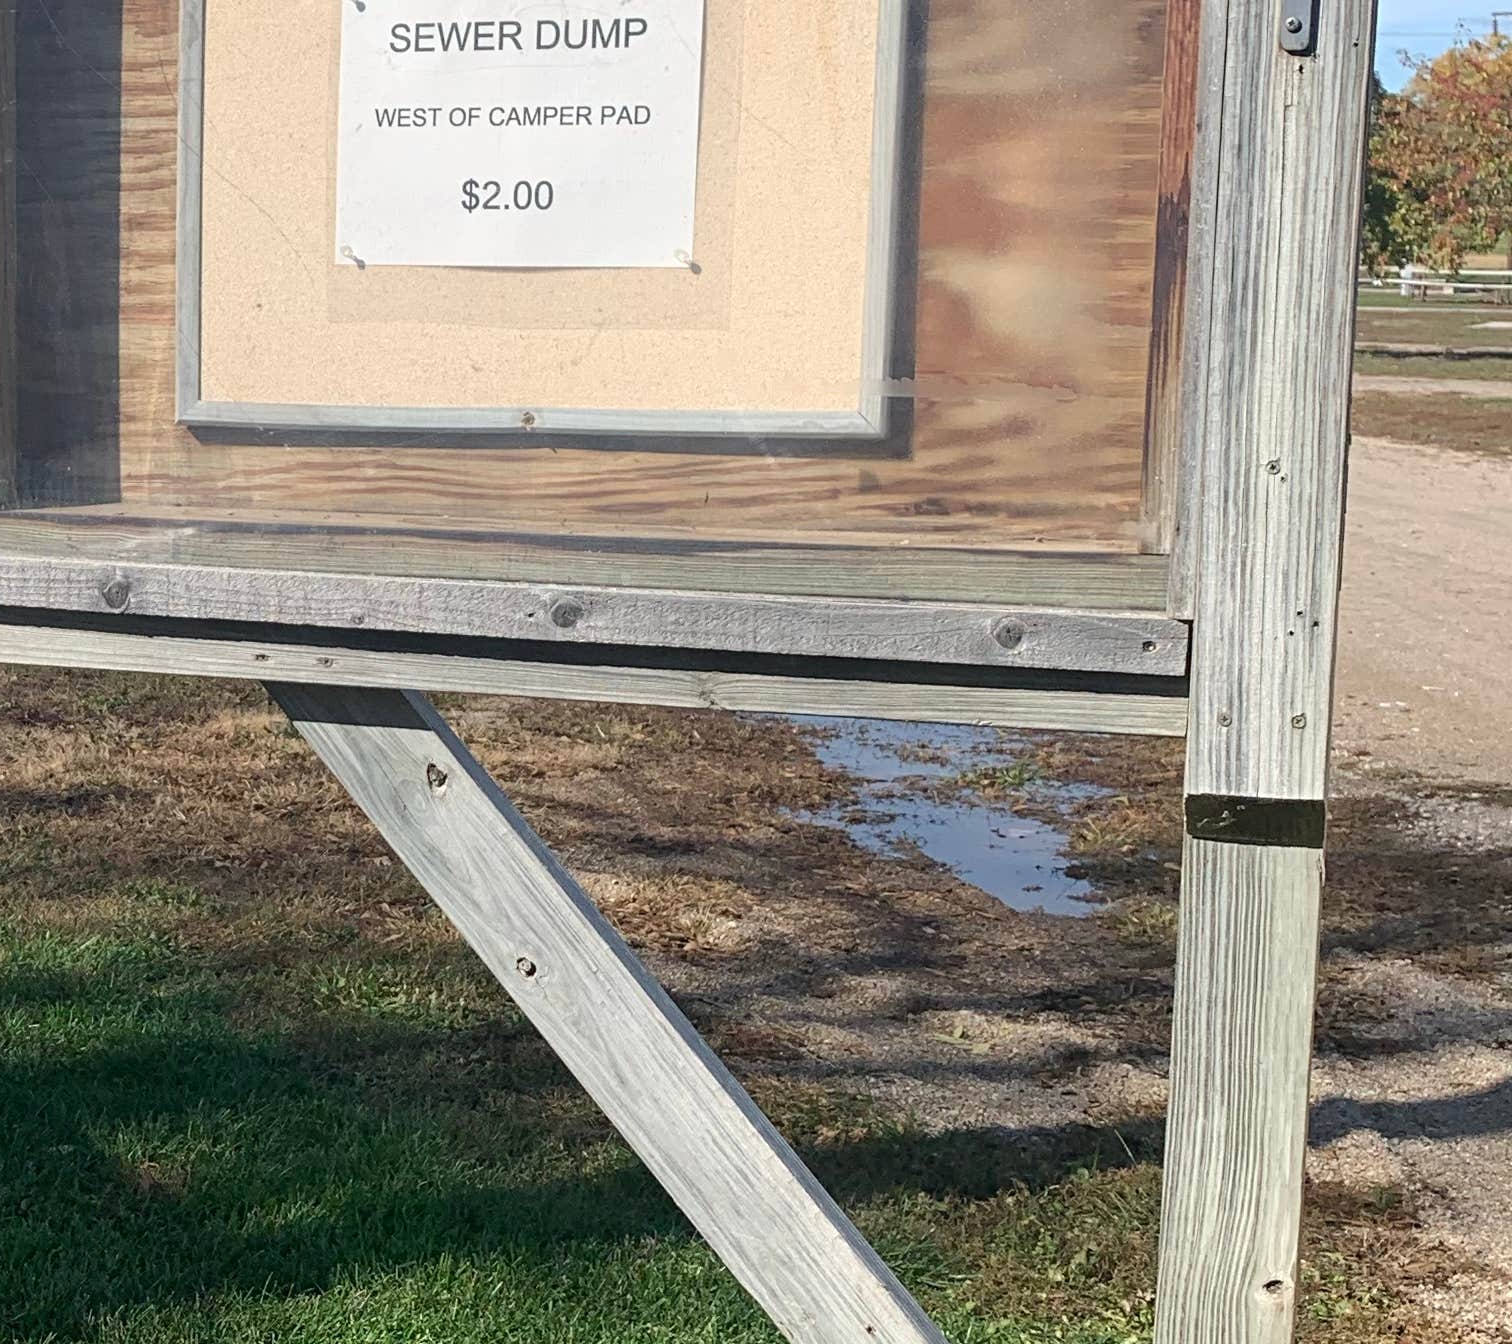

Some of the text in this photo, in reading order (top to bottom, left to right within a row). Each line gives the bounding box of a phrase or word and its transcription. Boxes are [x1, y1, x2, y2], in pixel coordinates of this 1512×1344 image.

[389, 18, 647, 52] SEWER DUMP
[375, 105, 651, 128] WEST OF CAMPER PAD
[461, 179, 554, 213] $2.00
